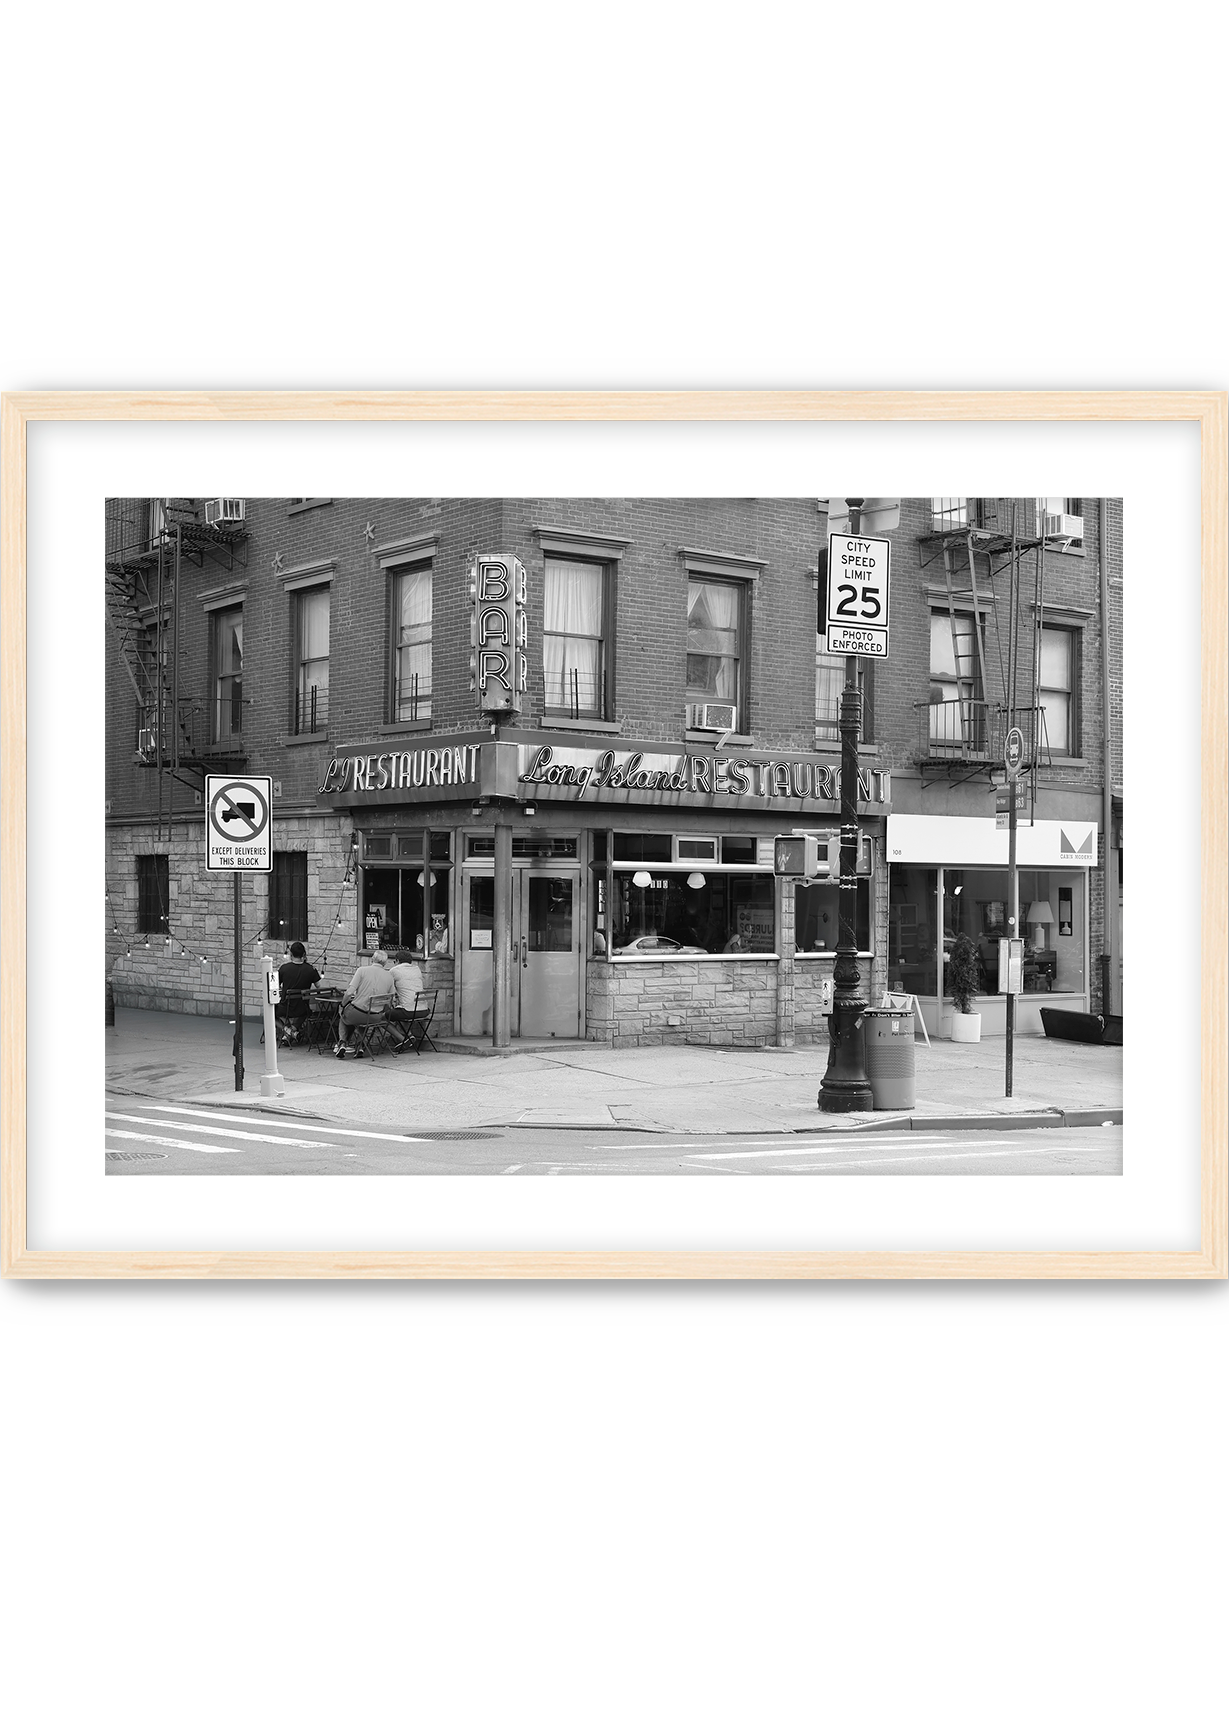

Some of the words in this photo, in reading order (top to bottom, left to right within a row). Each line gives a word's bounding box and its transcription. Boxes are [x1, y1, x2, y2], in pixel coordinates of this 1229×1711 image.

[847, 541, 871, 553] CITY
[841, 554, 876, 568] SPEED
[844, 569, 872, 581] LIMIT
[836, 584, 881, 619] 25
[479, 561, 511, 690] BAR
[842, 630, 874, 642] PHOTO
[832, 639, 883, 653] ENFORCED
[353, 744, 480, 791] RESTAURANT
[519, 745, 594, 799] Long
[591, 750, 689, 792] Island
[211, 847, 232, 856] EXCEPT
[234, 847, 267, 856] DELIVERIES
[219, 857, 235, 866] THIS
[237, 857, 259, 866] BLOCK
